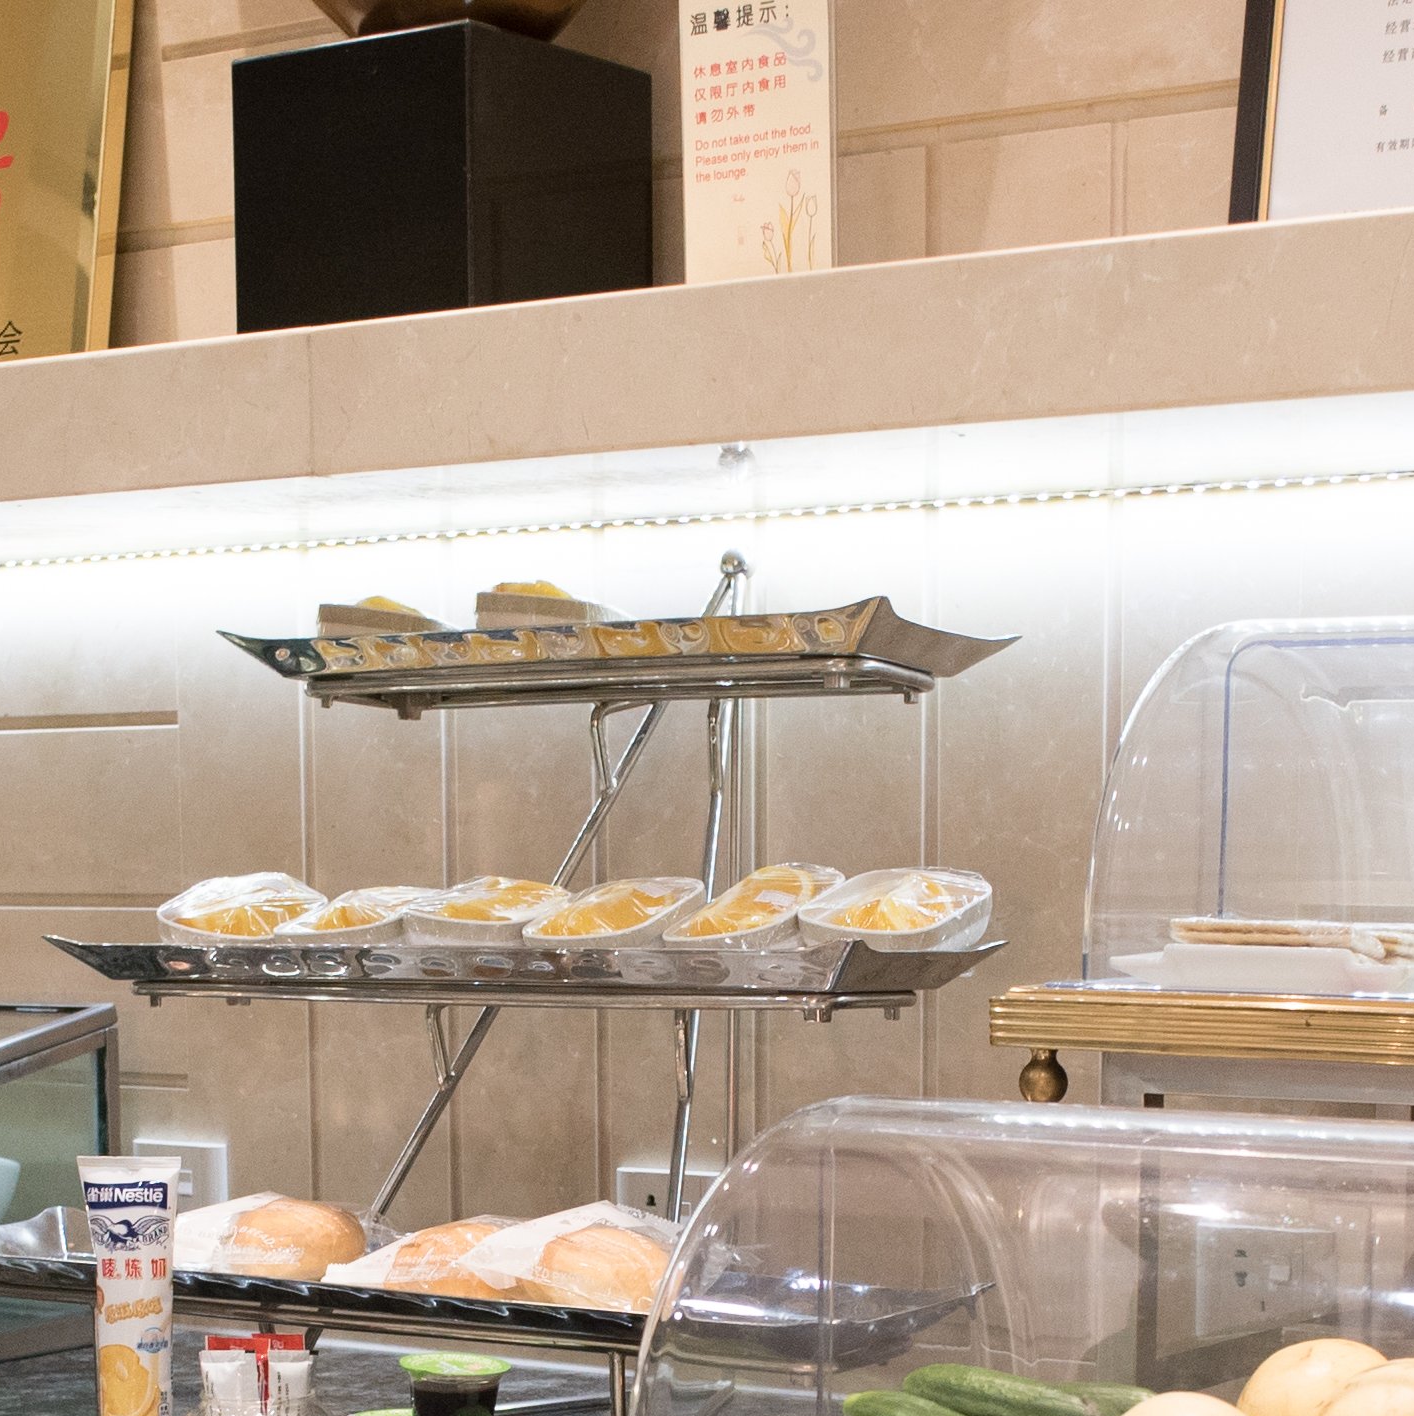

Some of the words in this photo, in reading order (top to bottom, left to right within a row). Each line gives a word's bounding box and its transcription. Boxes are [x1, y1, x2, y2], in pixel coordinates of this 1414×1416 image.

[693, 52, 787, 79] 休息室内食品
[694, 75, 787, 102] 仅限厅内食用
[695, 104, 756, 125] 请勿外带
[695, 140, 709, 151] Do
[711, 137, 727, 149] not
[730, 133, 750, 146] take
[753, 131, 769, 142] out
[771, 128, 786, 140] the
[789, 123, 811, 136] food
[695, 154, 728, 167] Please
[731, 150, 750, 163] only
[754, 147, 780, 162] enjoy
[783, 142, 808, 154] them
[810, 140, 819, 150] in
[696, 172, 710, 183] the
[713, 167, 746, 181] lounge
[113, 1187, 164, 1203] Nestlé
